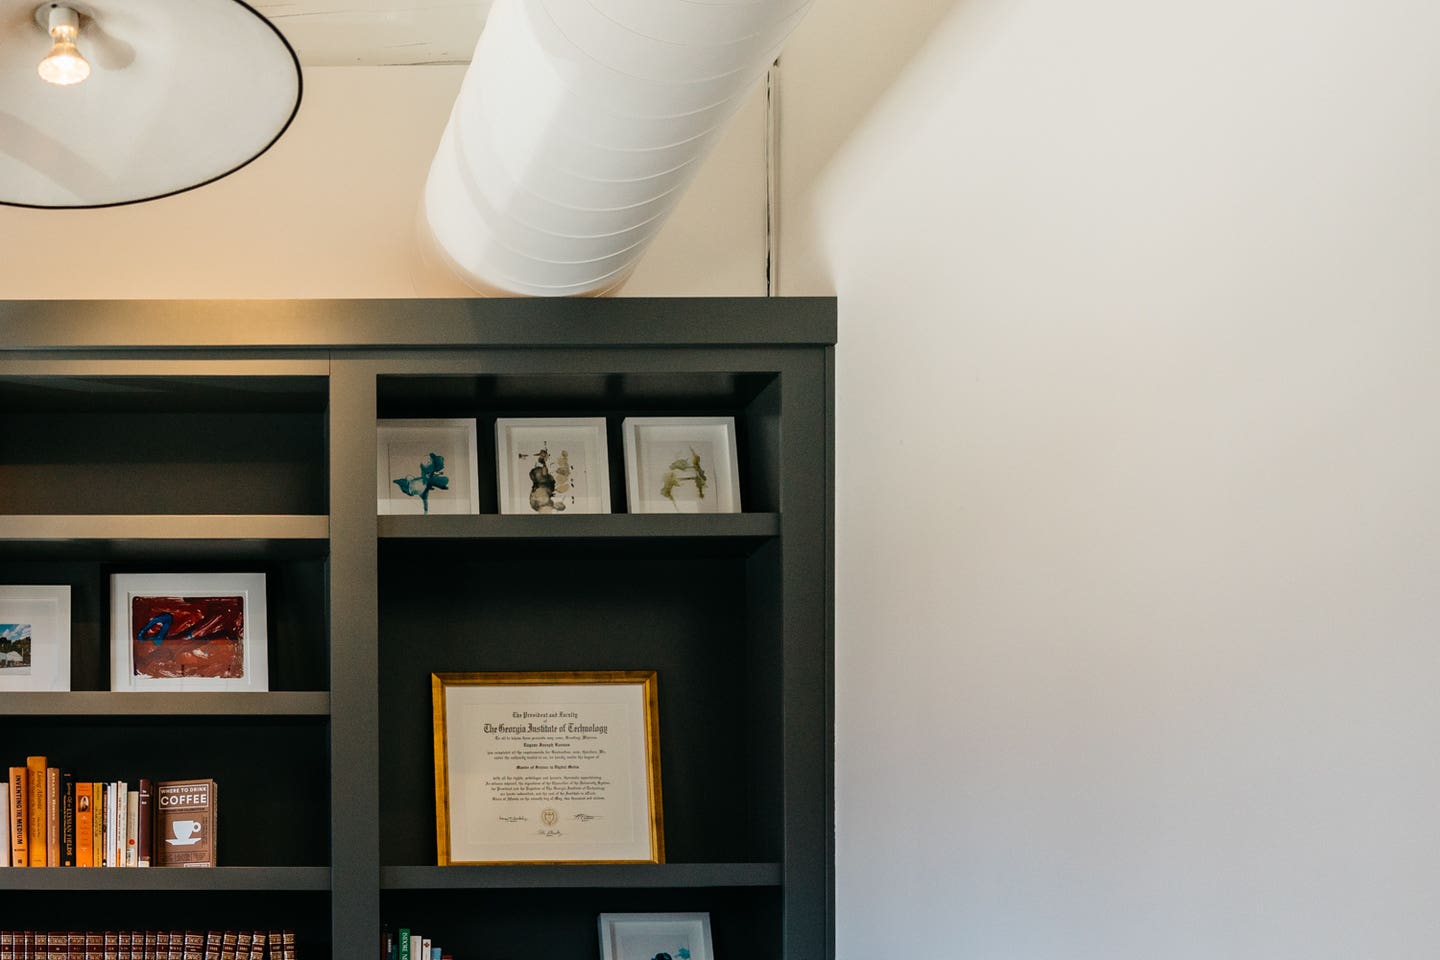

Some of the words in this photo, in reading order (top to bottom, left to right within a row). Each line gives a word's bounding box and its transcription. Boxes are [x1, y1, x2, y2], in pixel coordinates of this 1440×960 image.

[483, 723, 497, 733] The
[498, 723, 526, 735] Georgia
[527, 723, 558, 733] Institute
[558, 723, 566, 733] of
[567, 723, 608, 735] Technology
[160, 794, 207, 806] COFFEE
[16, 819, 24, 845] MEDIUM
